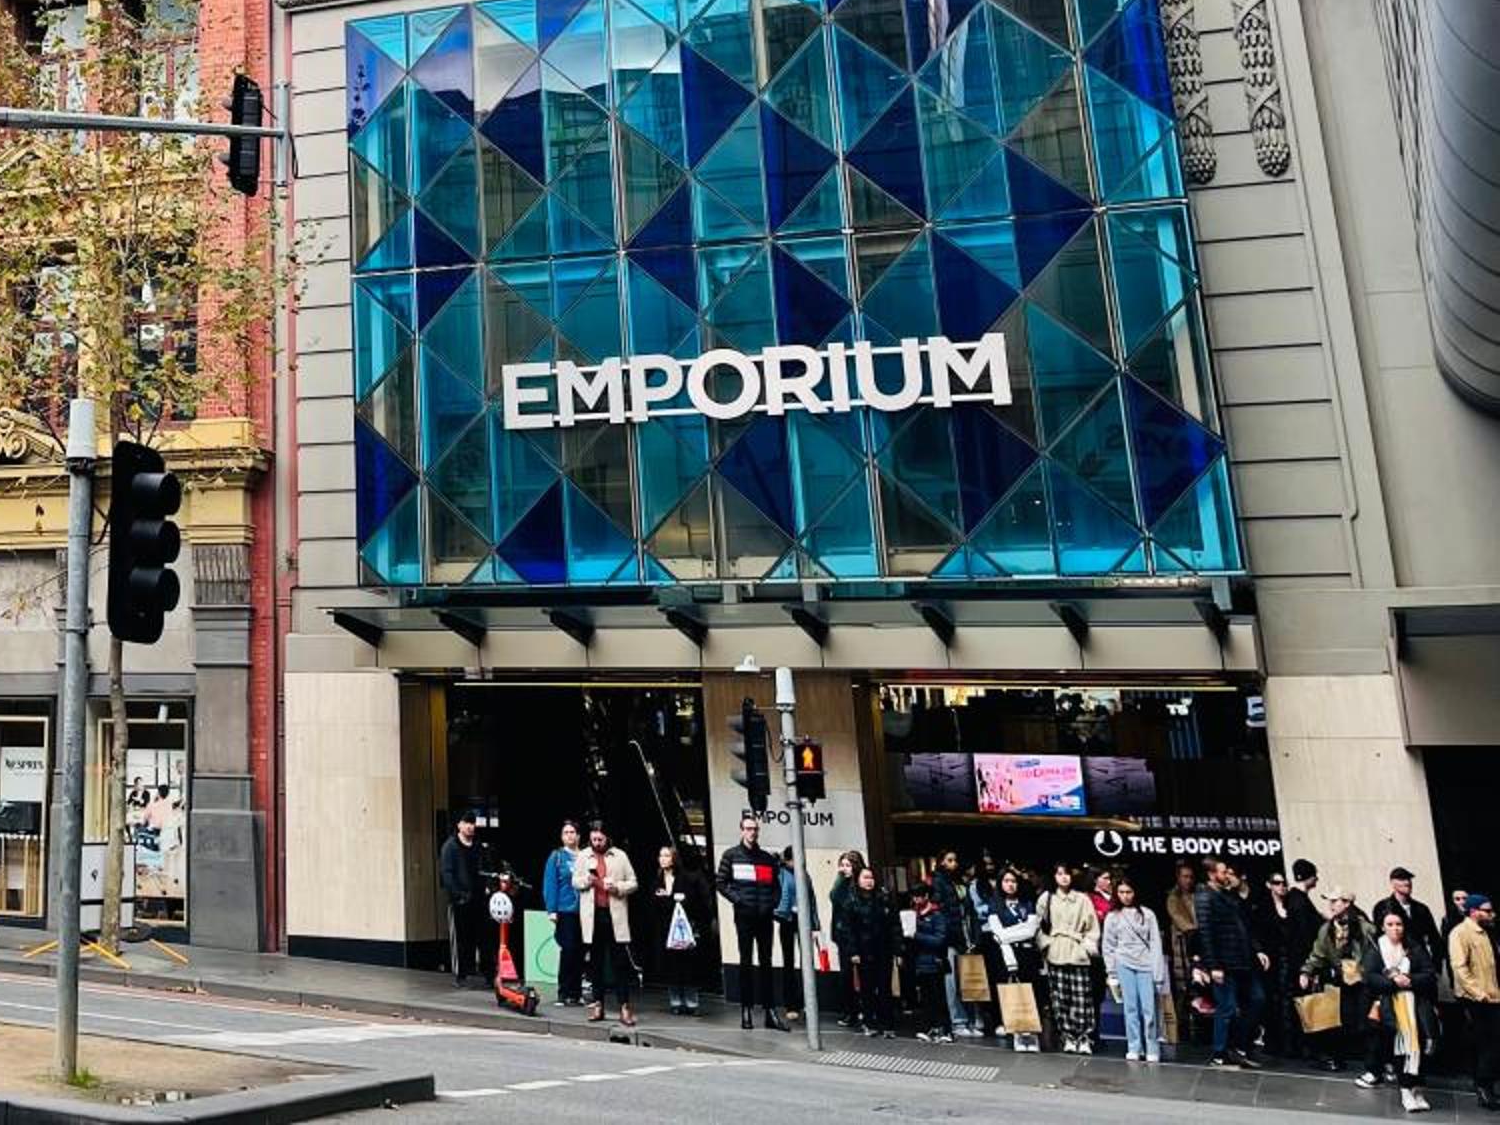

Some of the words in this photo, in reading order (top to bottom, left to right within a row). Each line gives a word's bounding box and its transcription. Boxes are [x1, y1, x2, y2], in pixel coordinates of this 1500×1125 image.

[501, 332, 1013, 430] EMPORIUM
[742, 809, 835, 827] EMPOIUM
[1128, 836, 1167, 854] THE
[1171, 838, 1223, 855] BODY
[1227, 839, 1282, 856] SHOP
